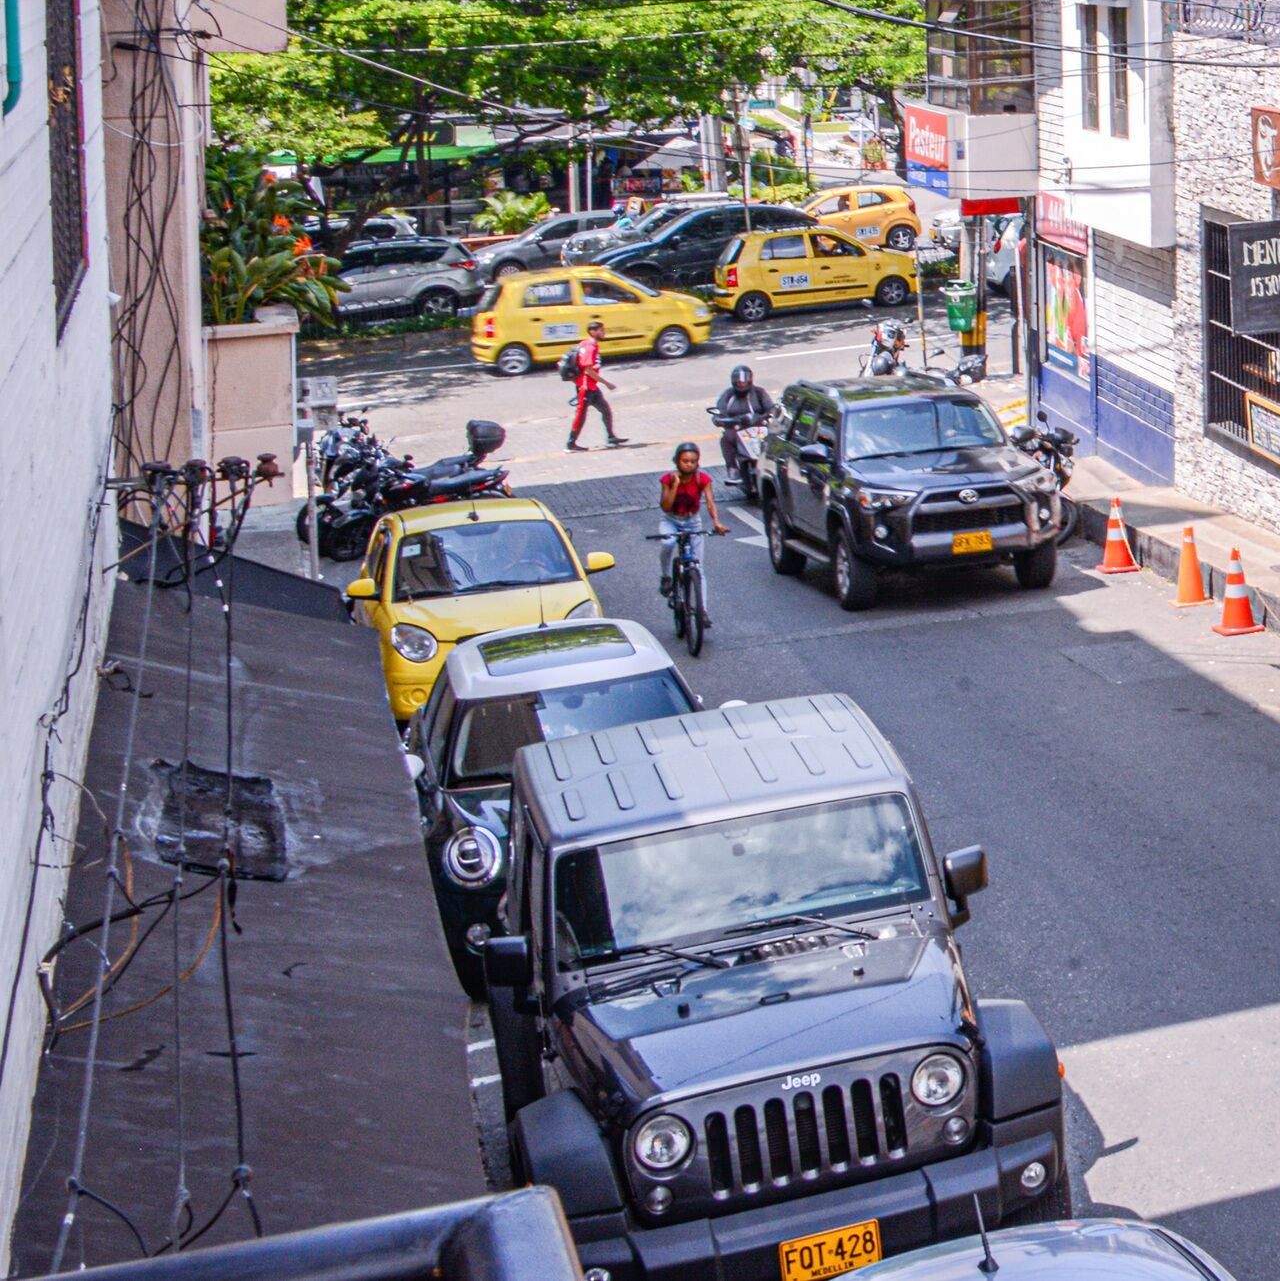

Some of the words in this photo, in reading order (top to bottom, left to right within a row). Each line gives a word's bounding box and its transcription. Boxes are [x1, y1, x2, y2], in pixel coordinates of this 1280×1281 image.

[910, 116, 946, 162] Pasteur
[782, 1073, 821, 1090] Jeep
[811, 1261, 855, 1277] MEDELLIN
